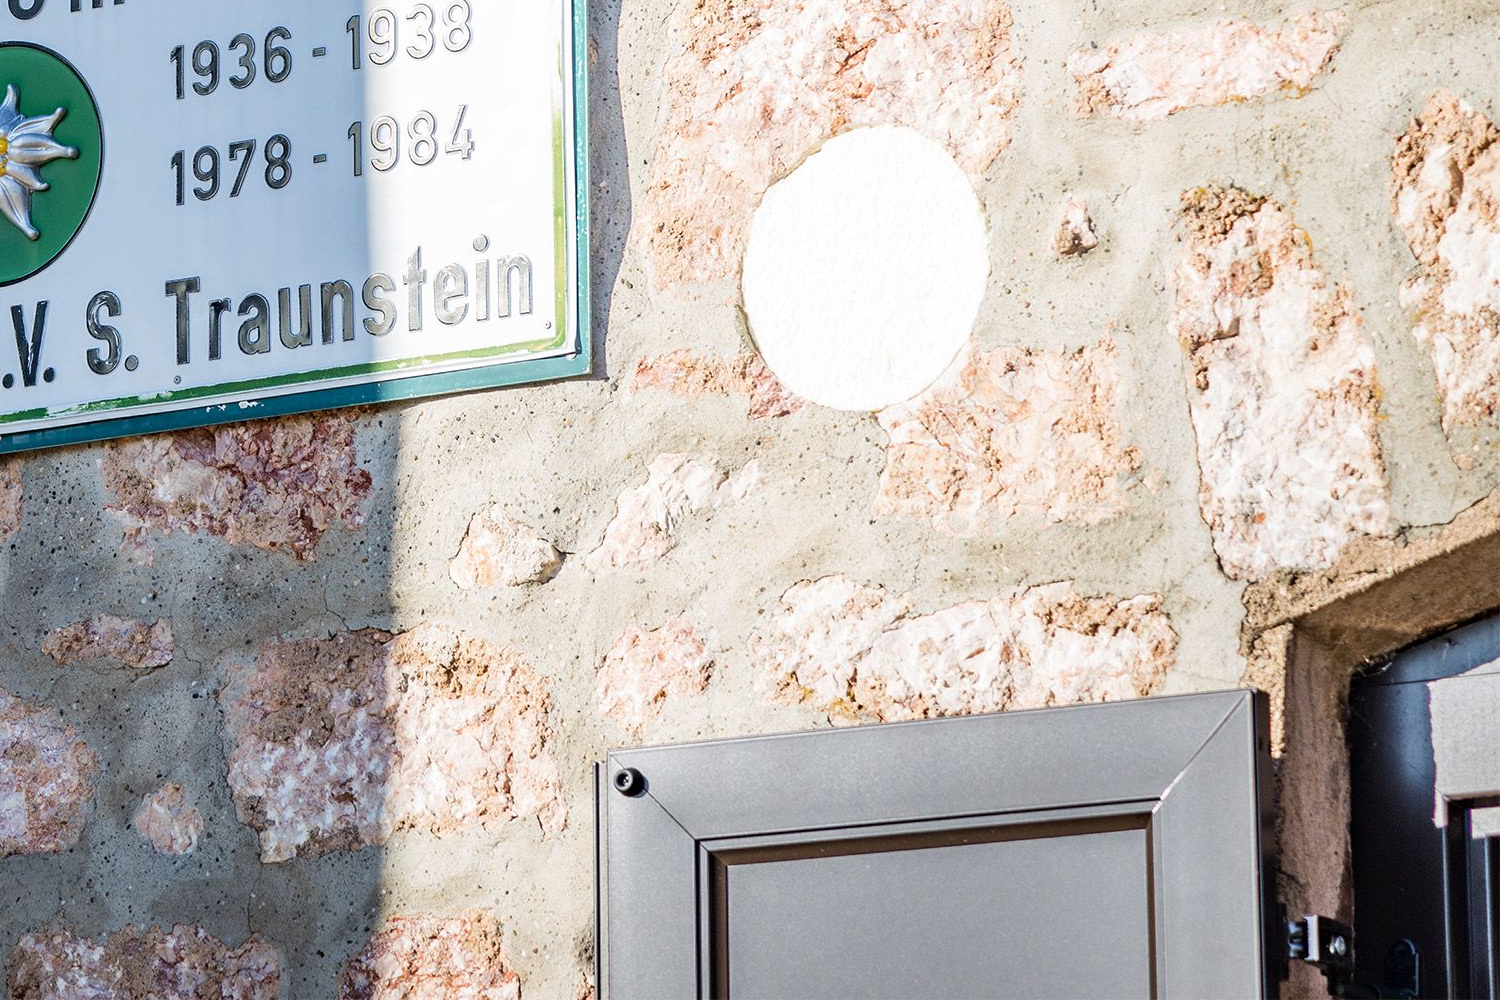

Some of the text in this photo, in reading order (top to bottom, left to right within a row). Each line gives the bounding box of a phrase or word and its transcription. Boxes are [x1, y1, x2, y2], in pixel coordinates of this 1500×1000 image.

[169, 26, 293, 100] 1936
[169, 133, 293, 206] 1978
[346, 104, 476, 177] 1984
[85, 291, 140, 376] S.
[165, 234, 534, 366] Traunstein
